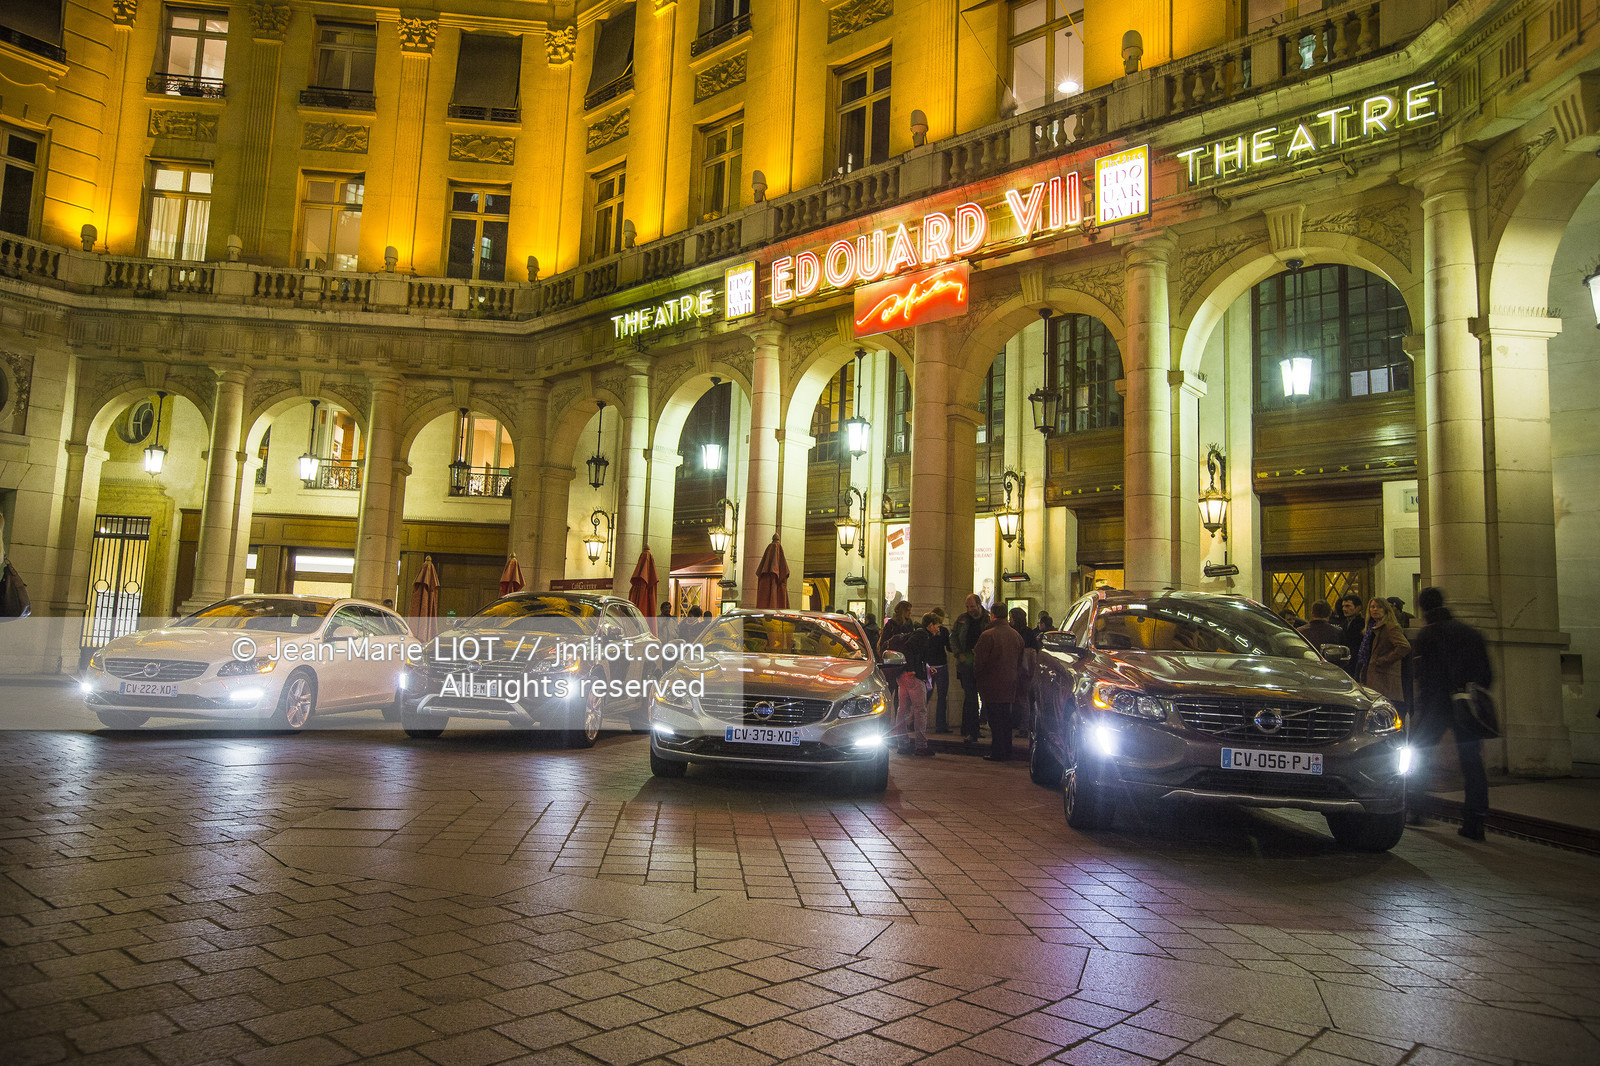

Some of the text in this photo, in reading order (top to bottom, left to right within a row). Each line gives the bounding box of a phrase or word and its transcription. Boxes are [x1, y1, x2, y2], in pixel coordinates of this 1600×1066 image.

[1177, 80, 1436, 183] THEATRE
[1103, 164, 1143, 187] EDO
[1103, 182, 1142, 204] UAR
[772, 202, 988, 305] EDOUARD
[1006, 171, 1083, 239] VII
[611, 289, 714, 340] THEATRE
